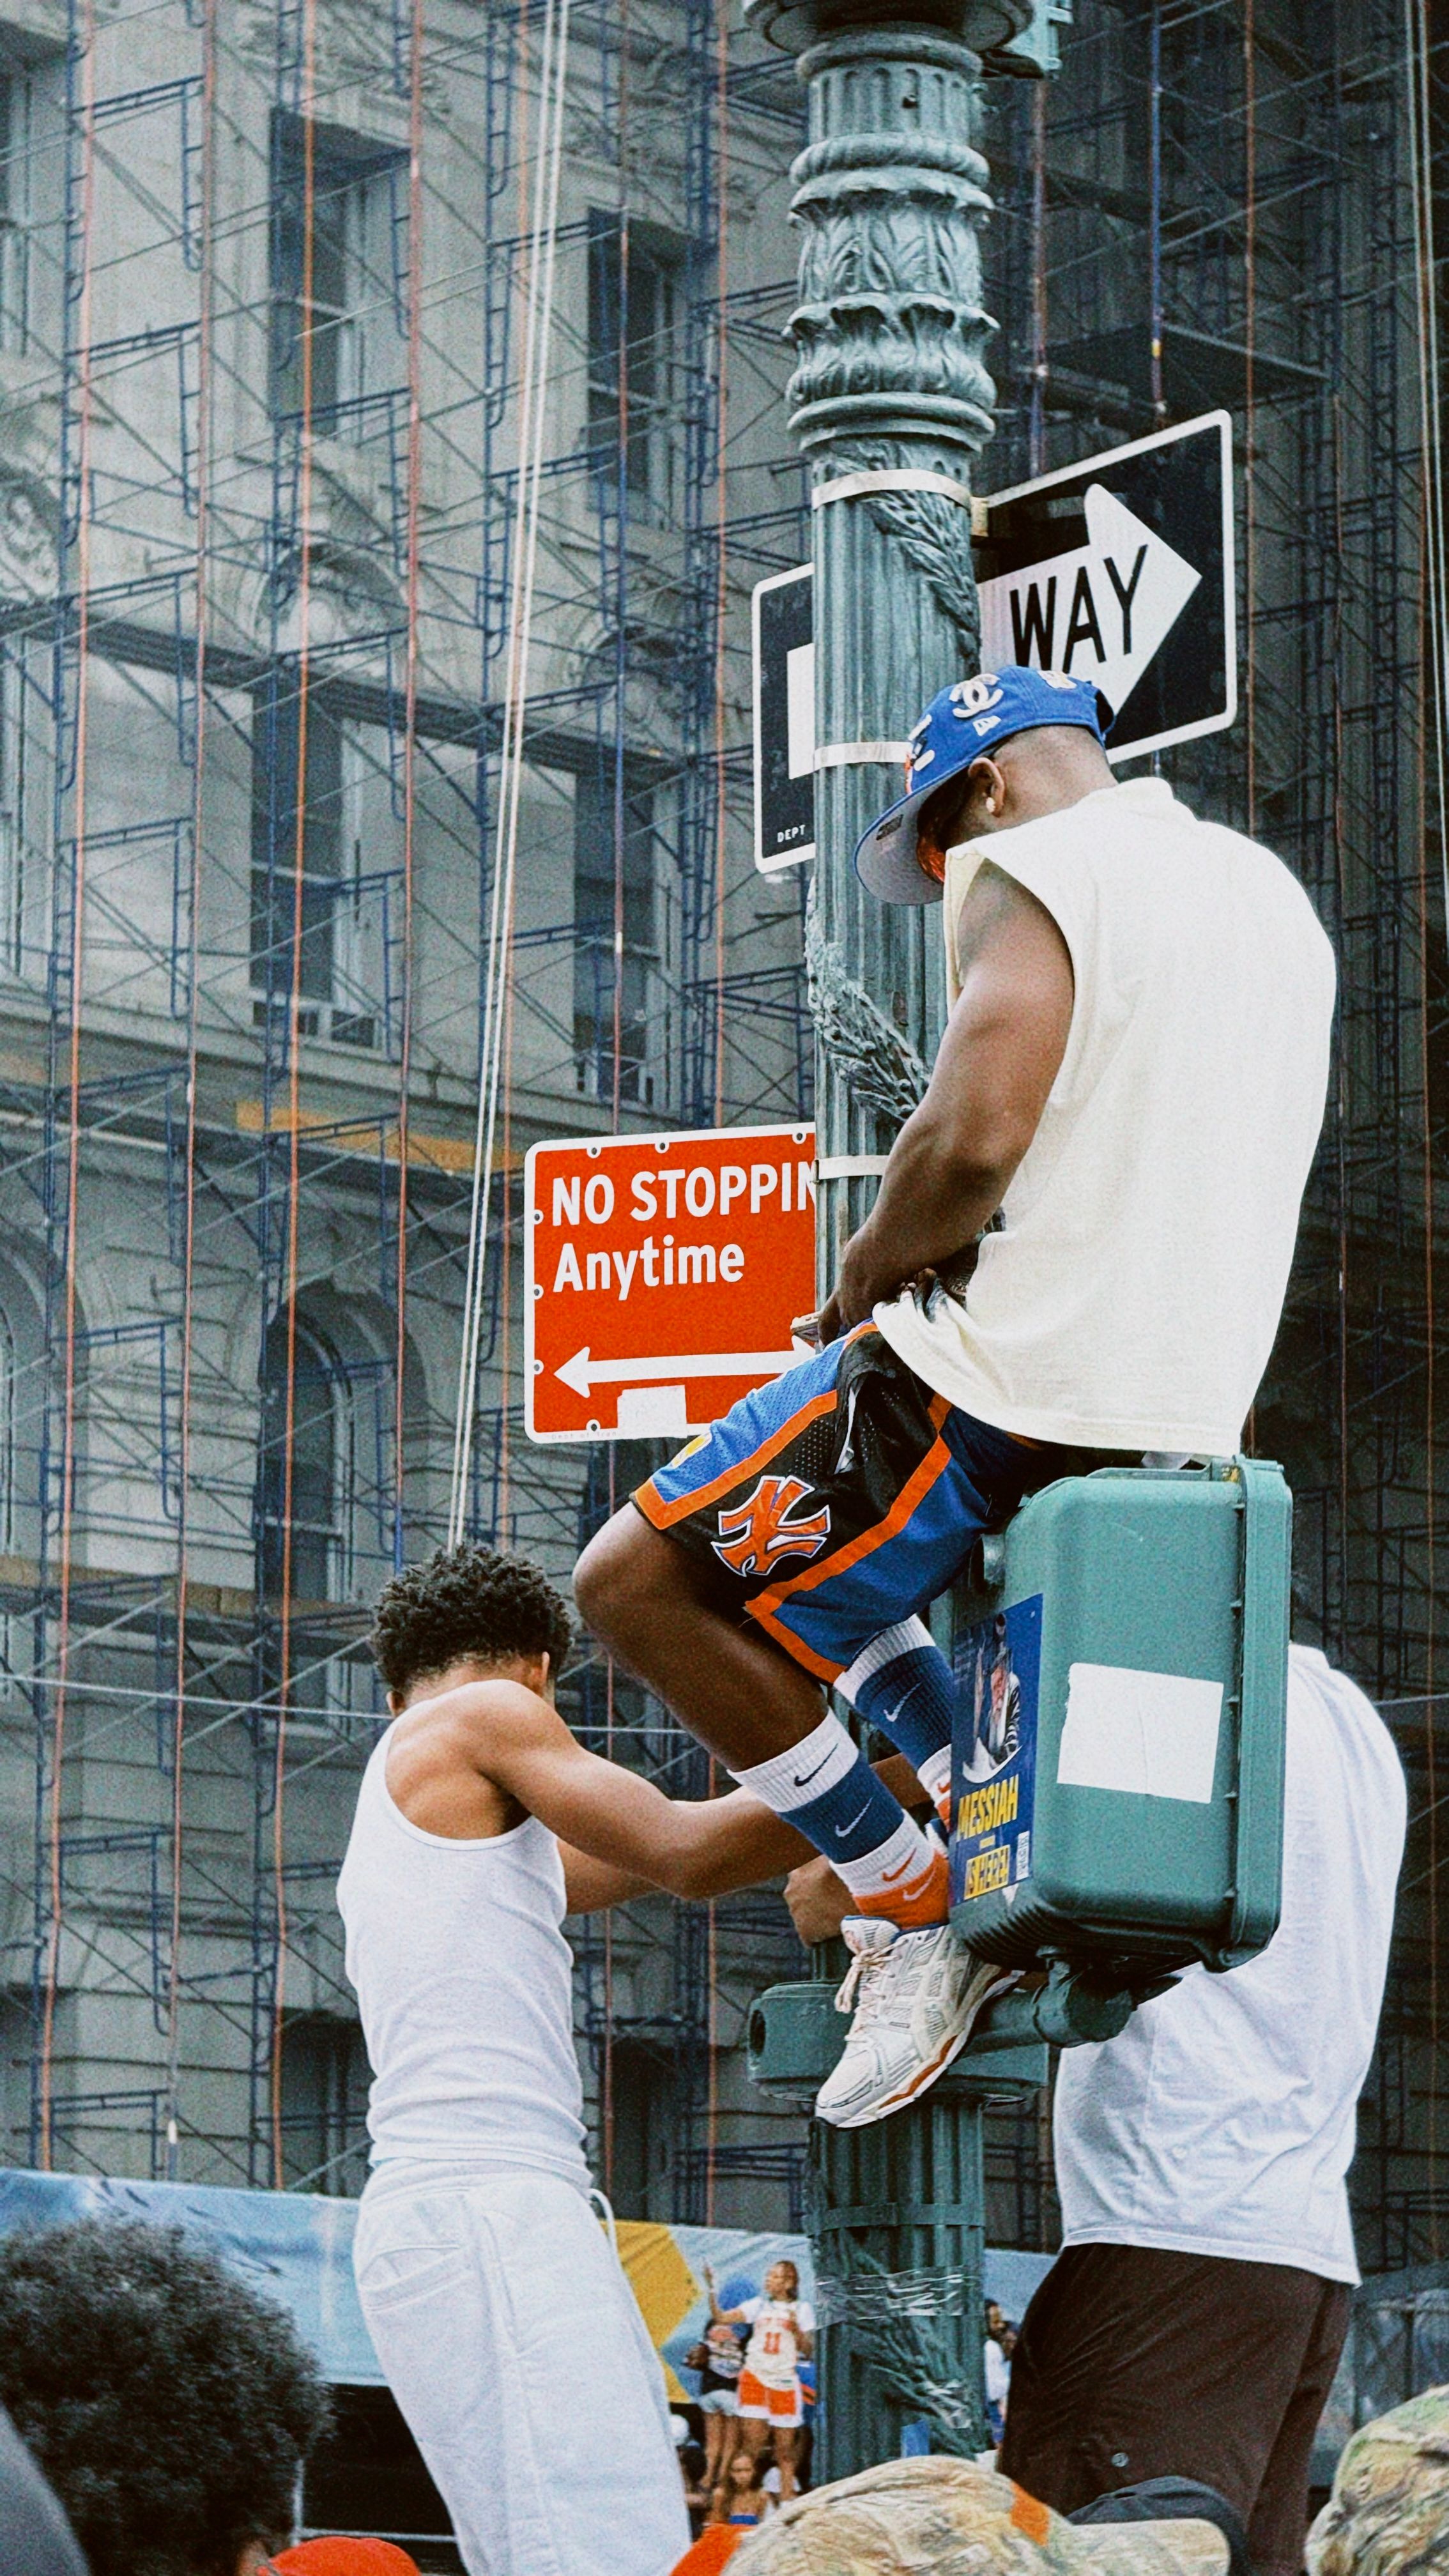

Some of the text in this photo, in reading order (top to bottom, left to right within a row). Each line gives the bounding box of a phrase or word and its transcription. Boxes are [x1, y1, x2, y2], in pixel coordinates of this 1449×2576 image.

[1009, 544, 1148, 674] WAY
[777, 824, 806, 843] DEPT
[552, 1161, 816, 1227] NO STOPPIN
[553, 1234, 745, 1301] Anytime
[956, 1774, 1019, 1843] MESSIAH
[763, 2331, 781, 2355] 11
